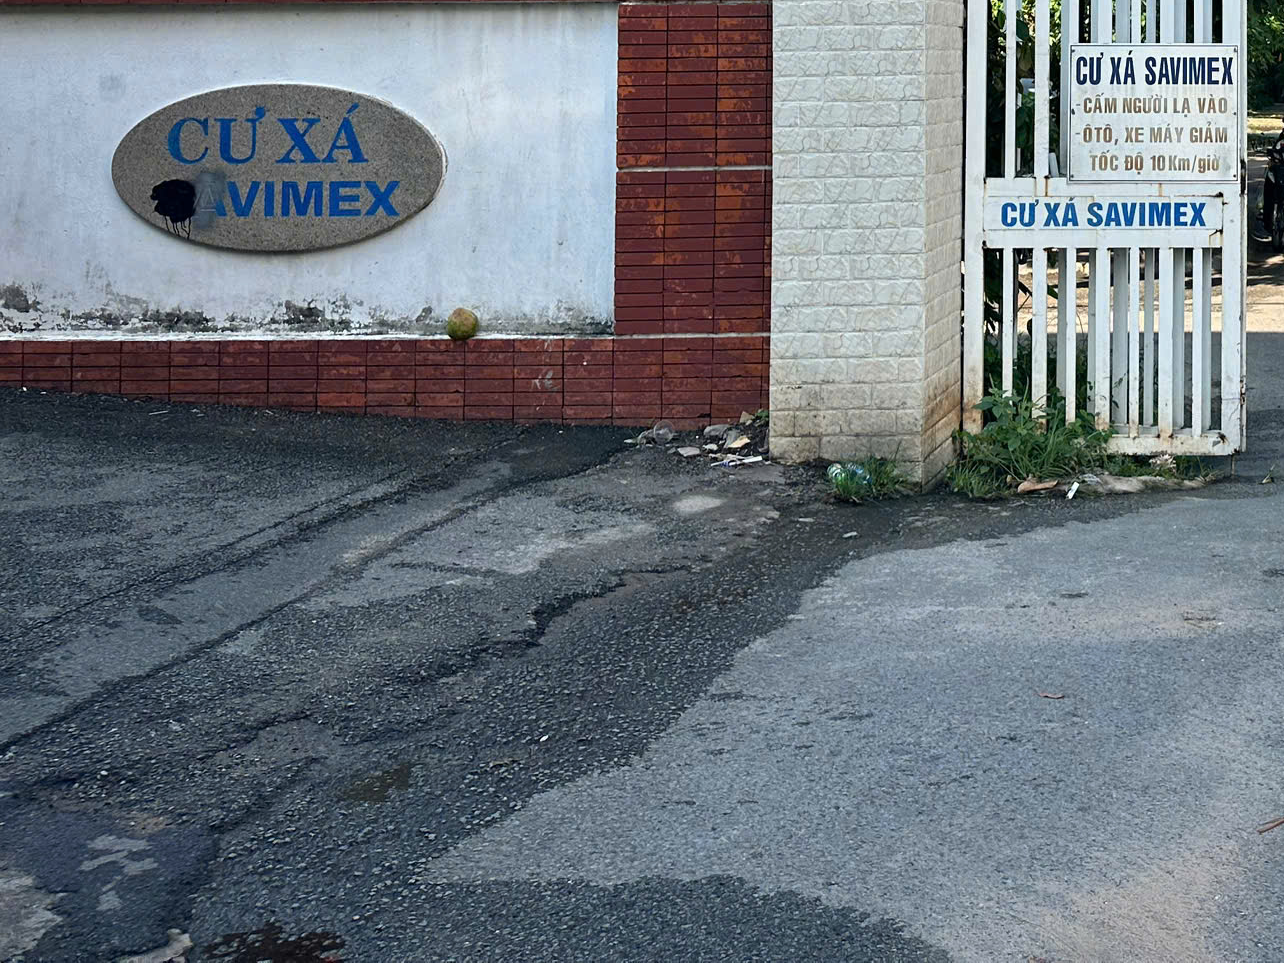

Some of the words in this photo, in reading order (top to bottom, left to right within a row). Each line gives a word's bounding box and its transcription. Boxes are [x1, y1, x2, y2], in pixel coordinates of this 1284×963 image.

[1076, 52, 1104, 85] CƯ
[1110, 50, 1136, 85] XÁ
[1144, 56, 1234, 86] SAVIMEX
[1122, 94, 1168, 114] NGƯỜI
[1172, 97, 1191, 118] LẠ
[1197, 94, 1228, 114] VÀO
[167, 106, 266, 164] CƯ
[276, 103, 369, 164] XÁ
[1124, 127, 1144, 143] XE
[1149, 124, 1184, 143] MÁY
[1189, 121, 1228, 143] GIẢM
[1089, 150, 1119, 171] TỐC
[1124, 152, 1144, 175] ĐỘ
[1001, 200, 1039, 227] CƯ
[1043, 197, 1079, 227] XÁ
[1087, 202, 1207, 227] SAVIMEX
